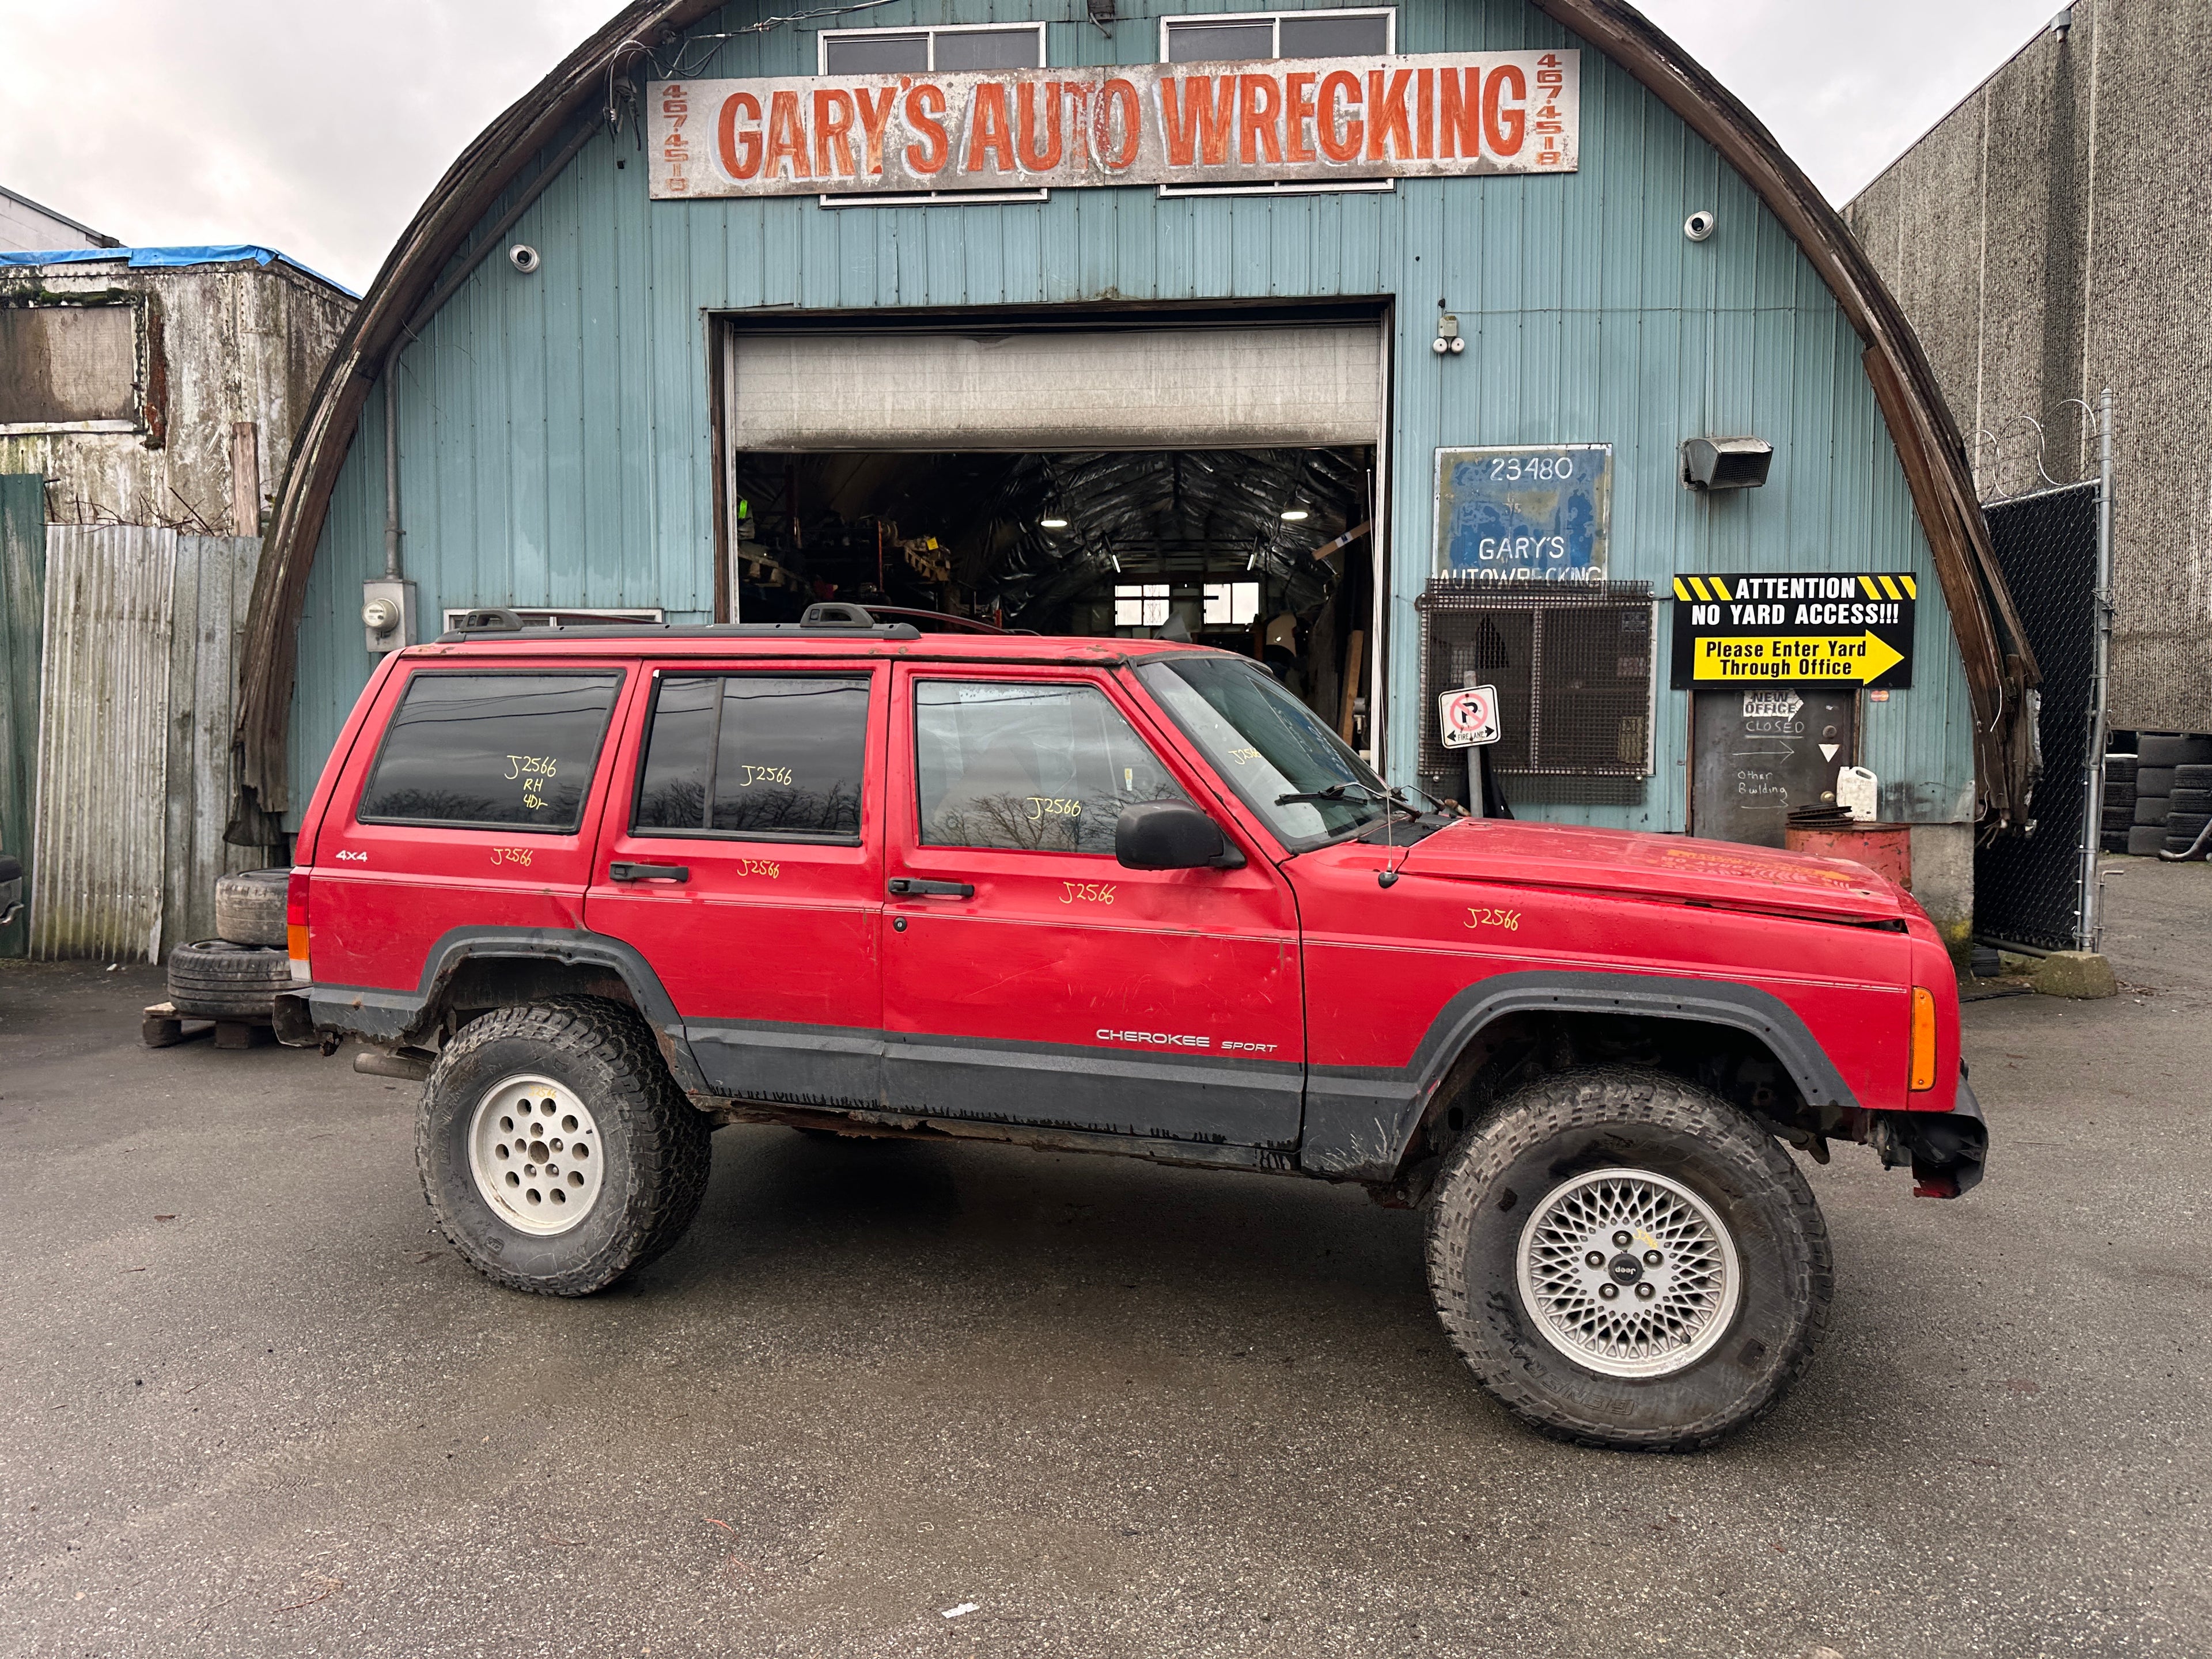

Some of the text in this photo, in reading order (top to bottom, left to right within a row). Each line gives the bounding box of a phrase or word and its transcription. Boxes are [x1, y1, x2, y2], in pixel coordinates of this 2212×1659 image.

[716, 63, 1527, 180] GARY'S AUTO WRECKING
[1490, 457, 1573, 482] 23480
[1479, 536, 1565, 560] GARY'S
[1734, 577, 1855, 600] ATTENTION
[1691, 603, 1899, 626] NO YARD ACCESS!!!
[1706, 640, 1866, 657] Please Enter Yard
[1720, 658, 1852, 678] Through Office
[1753, 691, 1787, 702] NEW
[1745, 703, 1796, 714] OFFICE
[1457, 731, 1486, 741] FIRE LANE
[1746, 720, 1804, 733] CLOSED
[504, 755, 556, 780] J2566
[740, 764, 792, 786] J2566
[523, 778, 543, 793] RH
[1738, 782, 1788, 800] Building
[1027, 797, 1082, 820] J2566
[335, 849, 368, 862] 4x4
[490, 847, 534, 867] J2566
[737, 858, 780, 880] J2566
[1059, 881, 1117, 905] J2566
[1463, 907, 1521, 931] J2566
[1096, 1029, 1278, 1053] CHEROKEE SPORT
